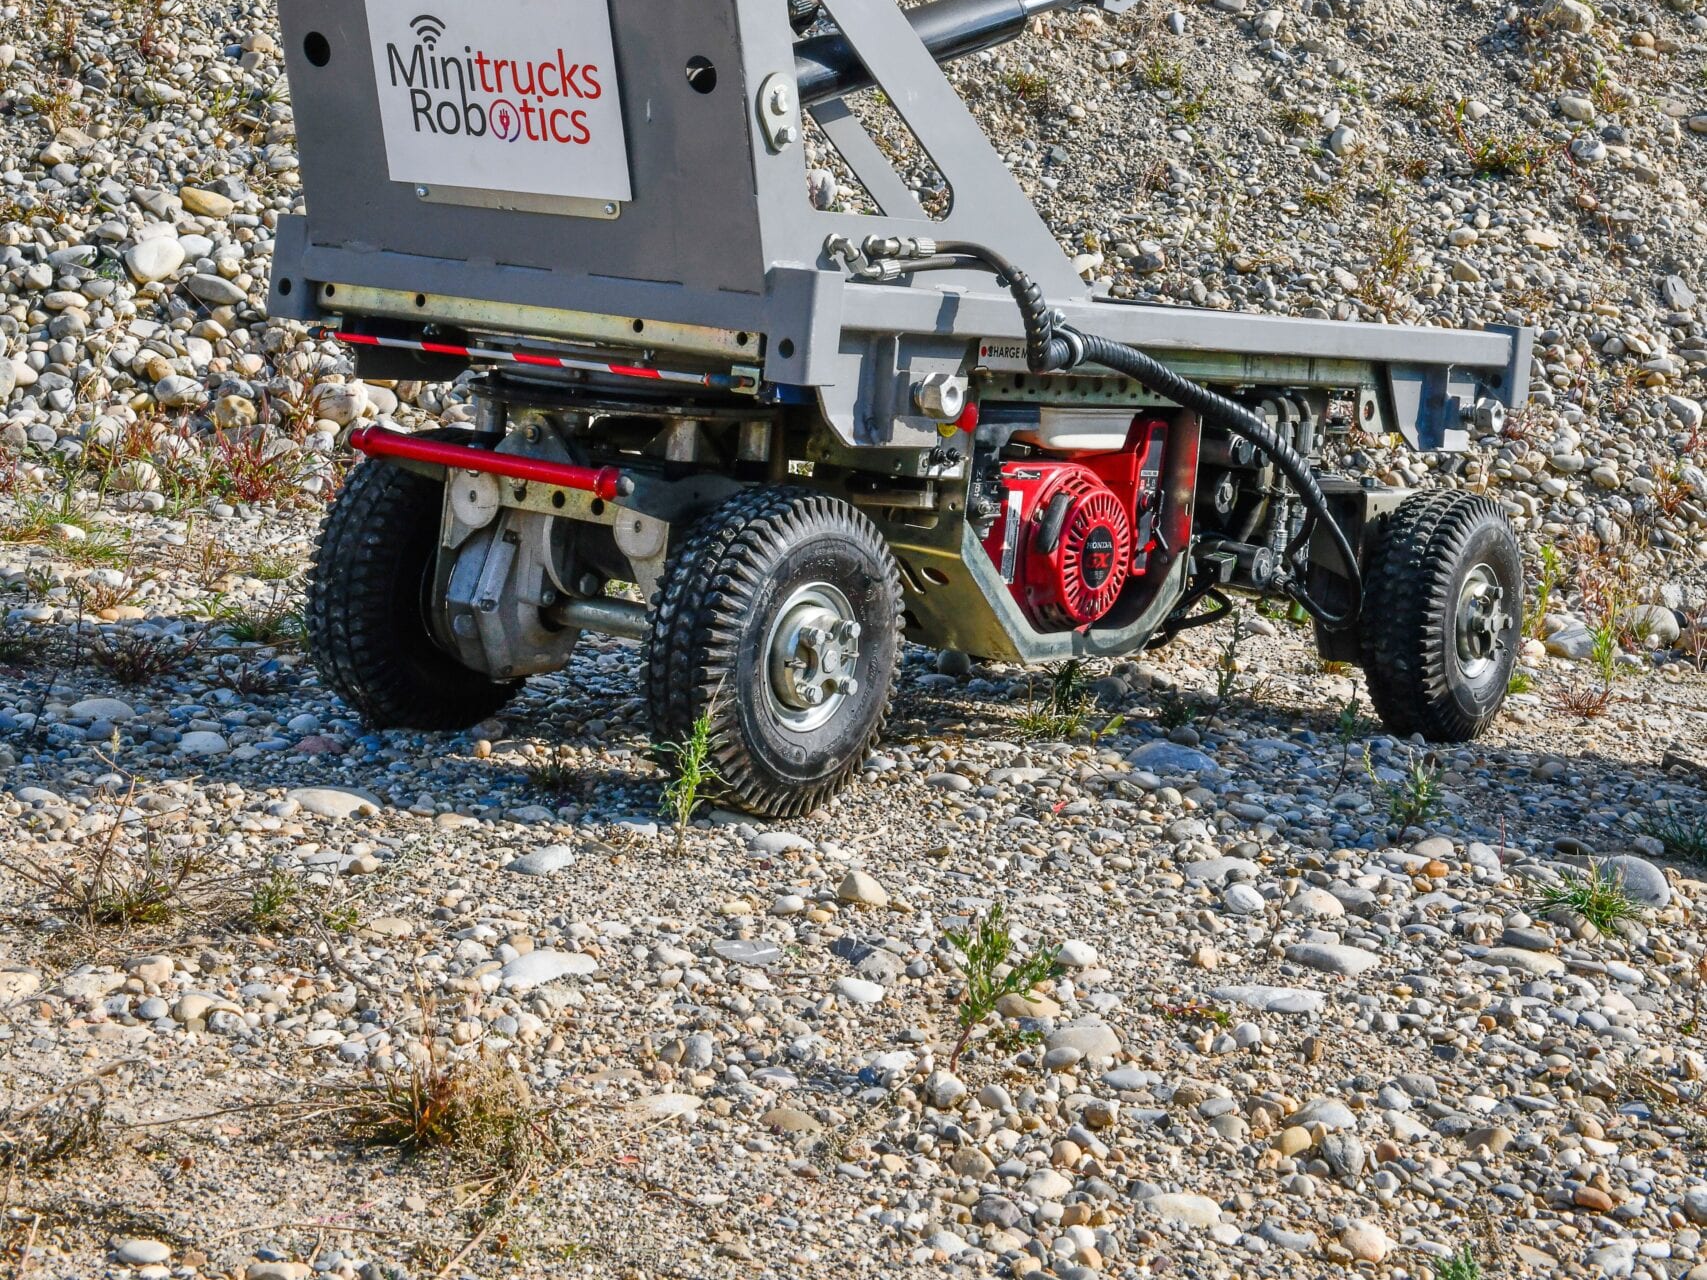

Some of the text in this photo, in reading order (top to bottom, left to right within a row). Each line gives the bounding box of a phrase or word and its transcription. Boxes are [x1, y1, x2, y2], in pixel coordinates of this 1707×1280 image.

[386, 42, 602, 100] Minitrucks
[410, 88, 591, 145] Robotics
[1086, 541, 1113, 549] HONDA
